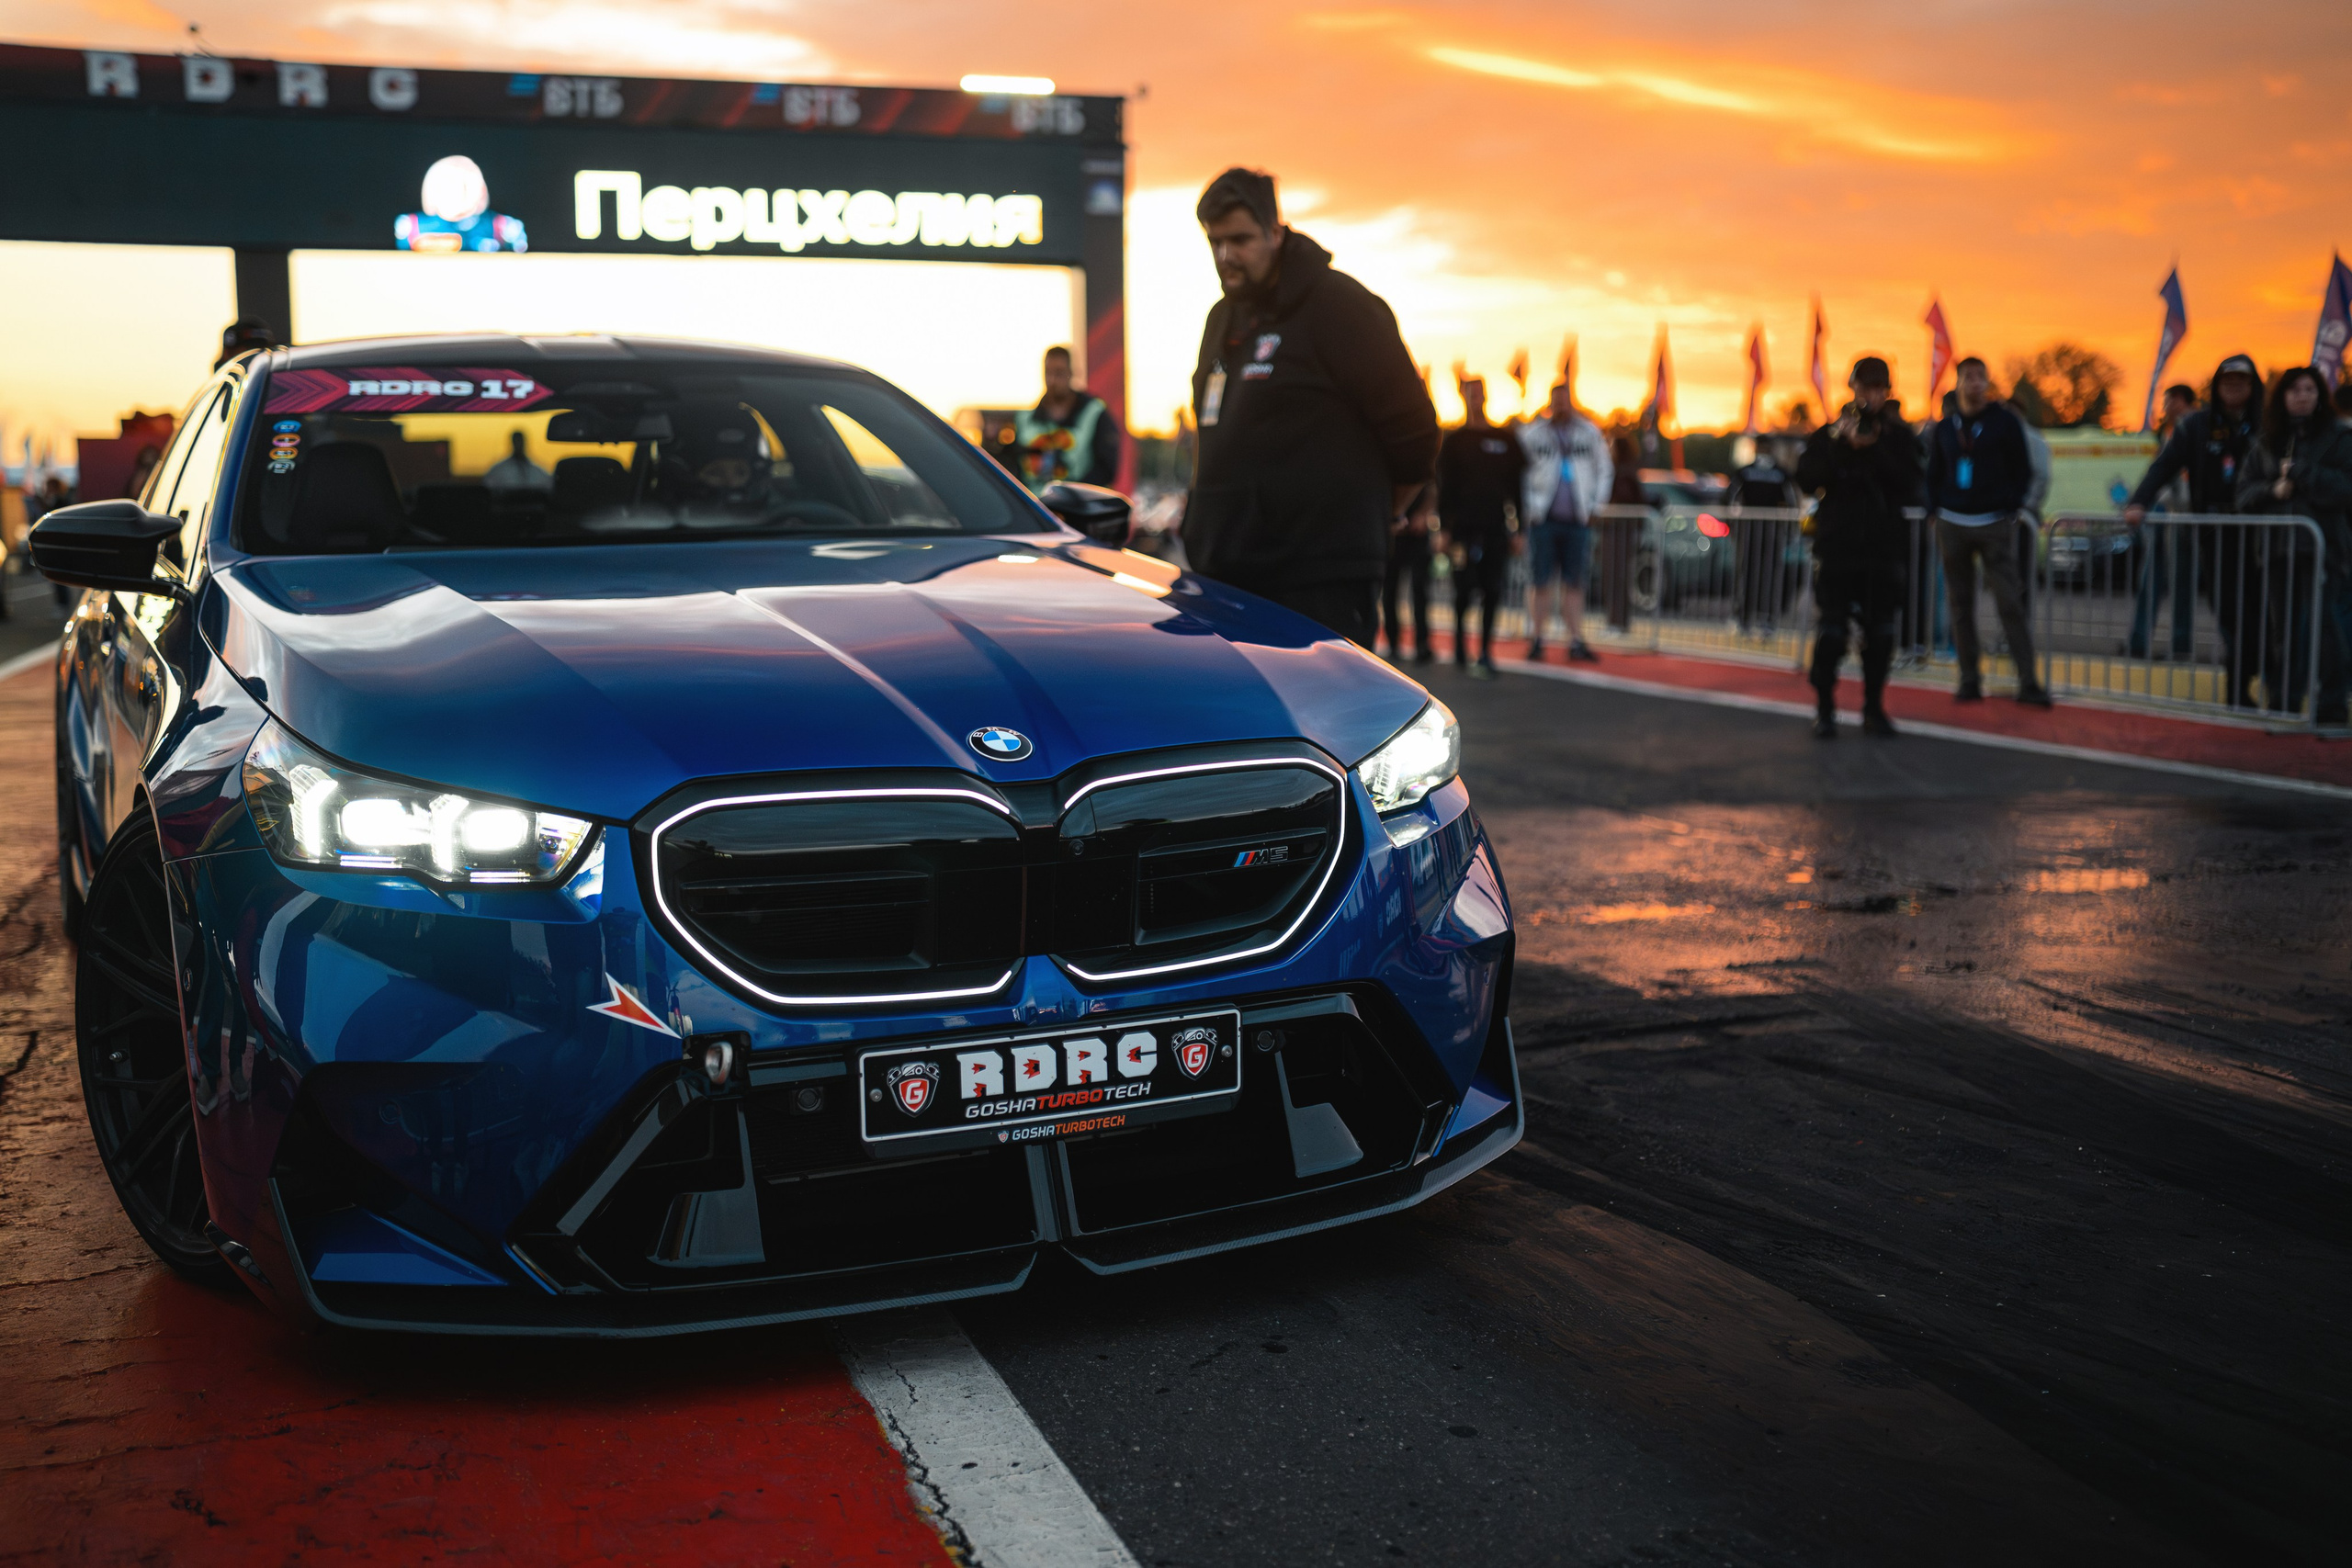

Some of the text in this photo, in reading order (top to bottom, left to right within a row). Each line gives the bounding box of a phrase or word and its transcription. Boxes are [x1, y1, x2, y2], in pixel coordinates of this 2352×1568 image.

[83, 51, 418, 111] RDRC
[574, 170, 1043, 252] Перцхелия
[348, 379, 535, 400] RDRC 17
[956, 1031, 1158, 1100] RDRC
[1187, 1046, 1202, 1068] G
[905, 1081, 924, 1104] G
[965, 1082, 1152, 1119] GOSHATURBOTECH
[1012, 1114, 1126, 1141] GOSHATURBOTECH
